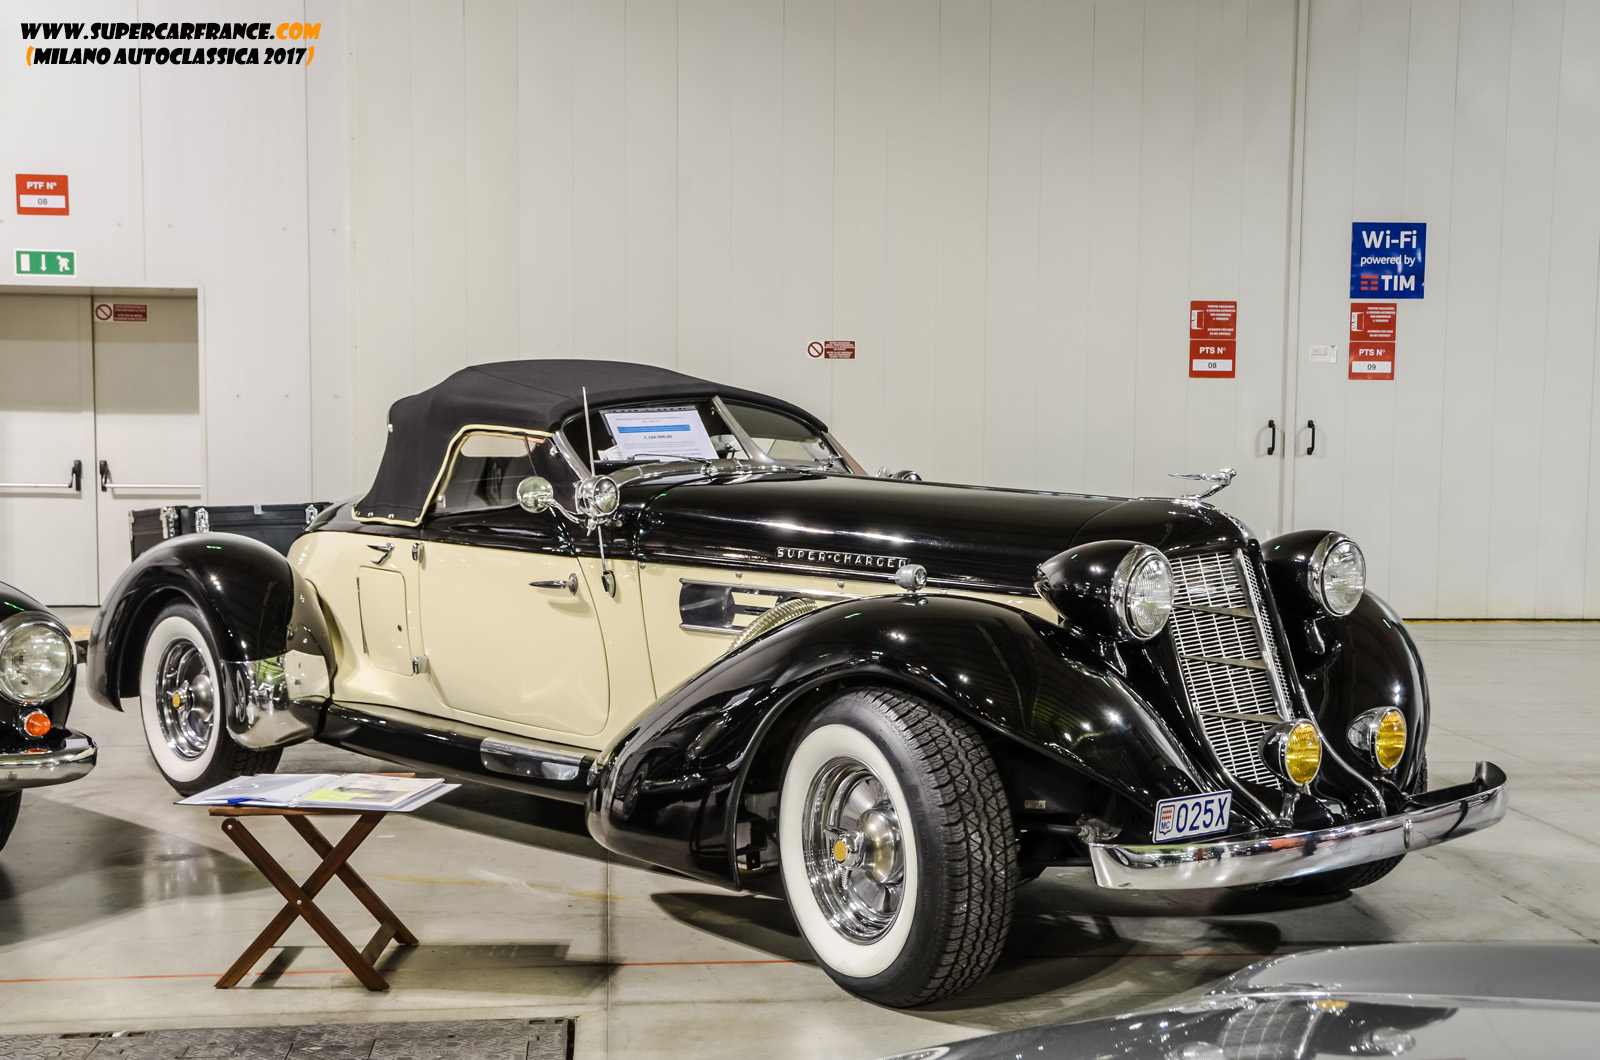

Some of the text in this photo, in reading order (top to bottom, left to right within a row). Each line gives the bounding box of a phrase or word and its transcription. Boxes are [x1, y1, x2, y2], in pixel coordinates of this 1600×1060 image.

[26, 181, 45, 190] PTF
[37, 197, 48, 205] 08
[1361, 229, 1417, 249] Wi-Fi
[1360, 254, 1416, 267] powered by
[1381, 274, 1416, 291] TIM
[1199, 346, 1216, 354] PTS
[1358, 348, 1375, 356] PTS
[1207, 361, 1217, 369] 08
[1366, 363, 1377, 371] 09
[1176, 797, 1228, 833] 025X
[1161, 821, 1171, 830] MC
